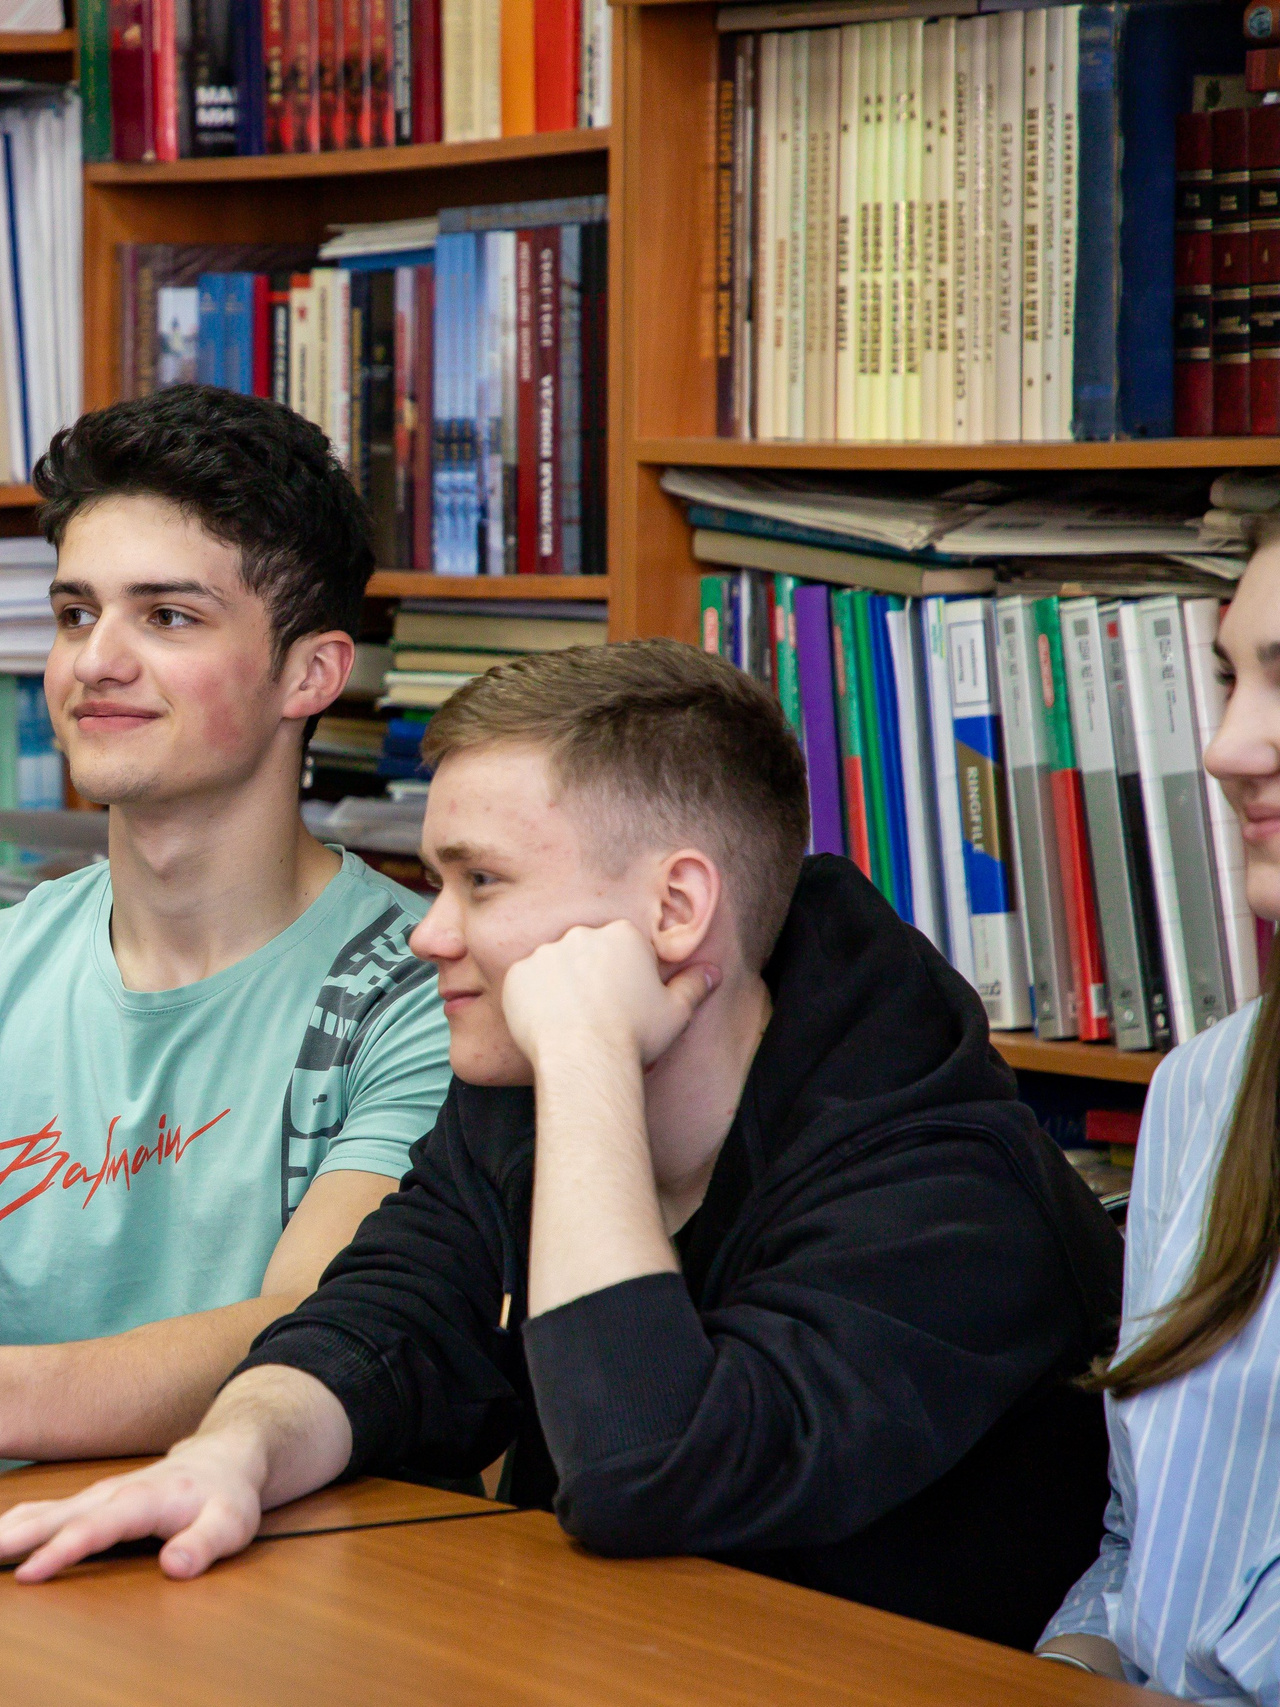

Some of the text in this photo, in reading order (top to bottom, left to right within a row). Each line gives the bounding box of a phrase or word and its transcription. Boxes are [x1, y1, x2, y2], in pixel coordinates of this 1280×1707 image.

[1000, 121, 1012, 335] АЛЕКСАНДР СУХАРЕВ
[539, 248, 554, 348] 1941-1945
[965, 765, 986, 855] RINGFILE
